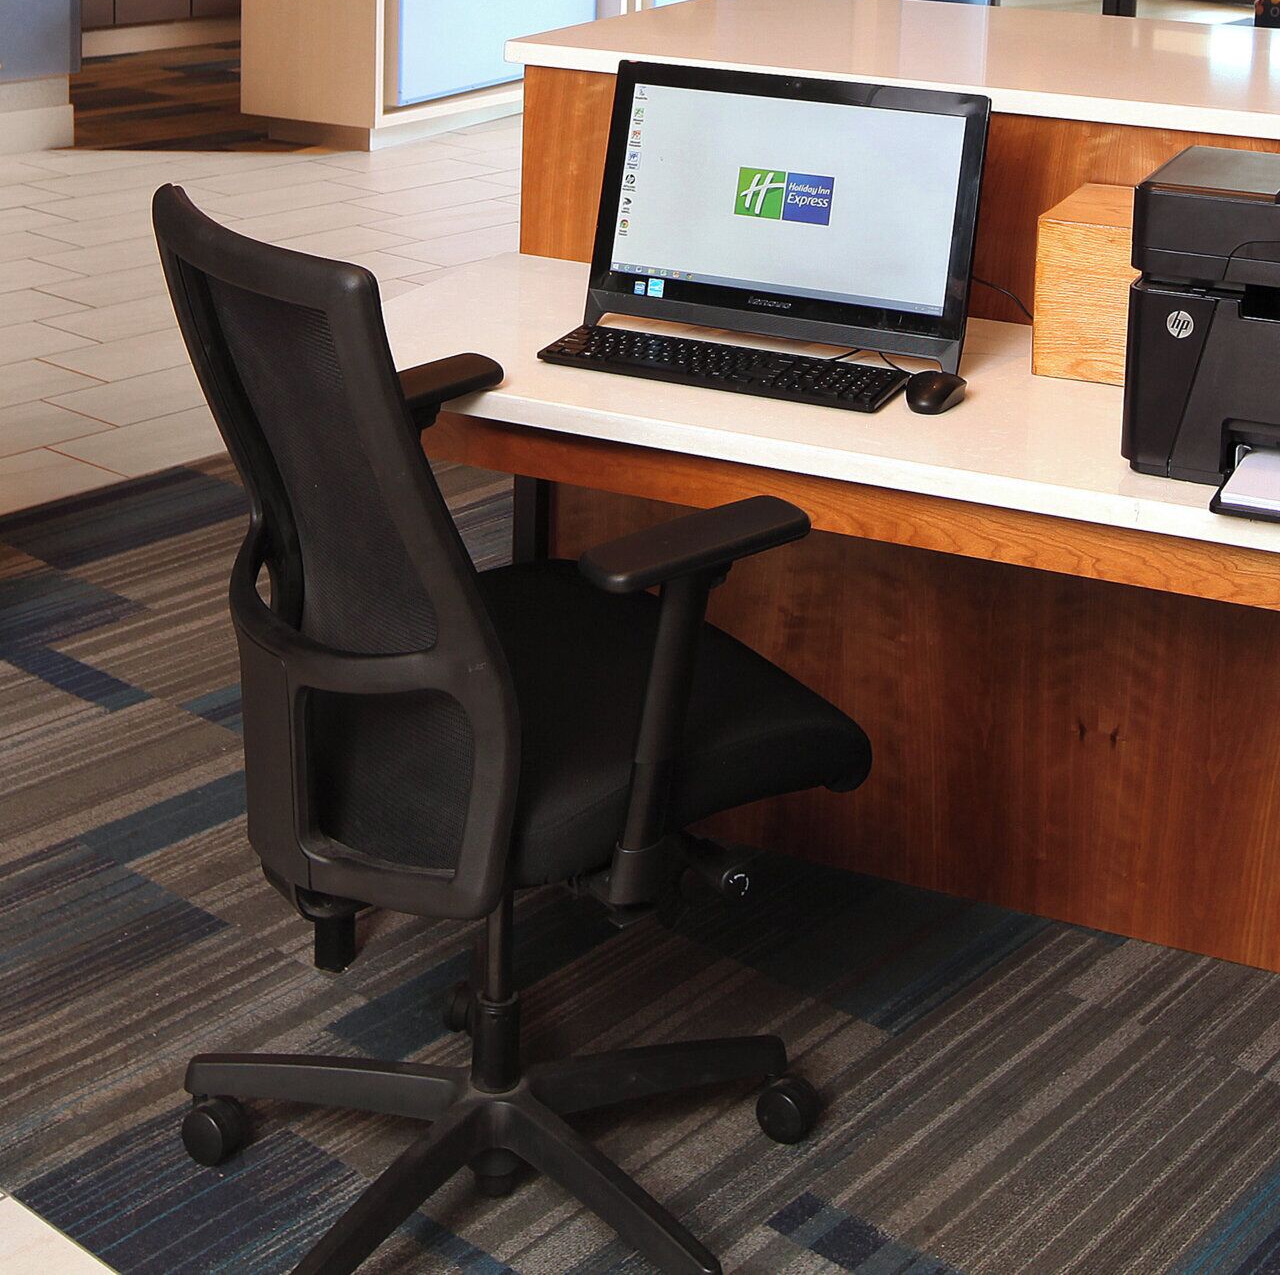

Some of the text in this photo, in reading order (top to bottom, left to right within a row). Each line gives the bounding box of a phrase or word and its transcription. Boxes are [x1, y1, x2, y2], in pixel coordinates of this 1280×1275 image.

[788, 182, 830, 195] Holiday Inn
[787, 192, 829, 208] Express
